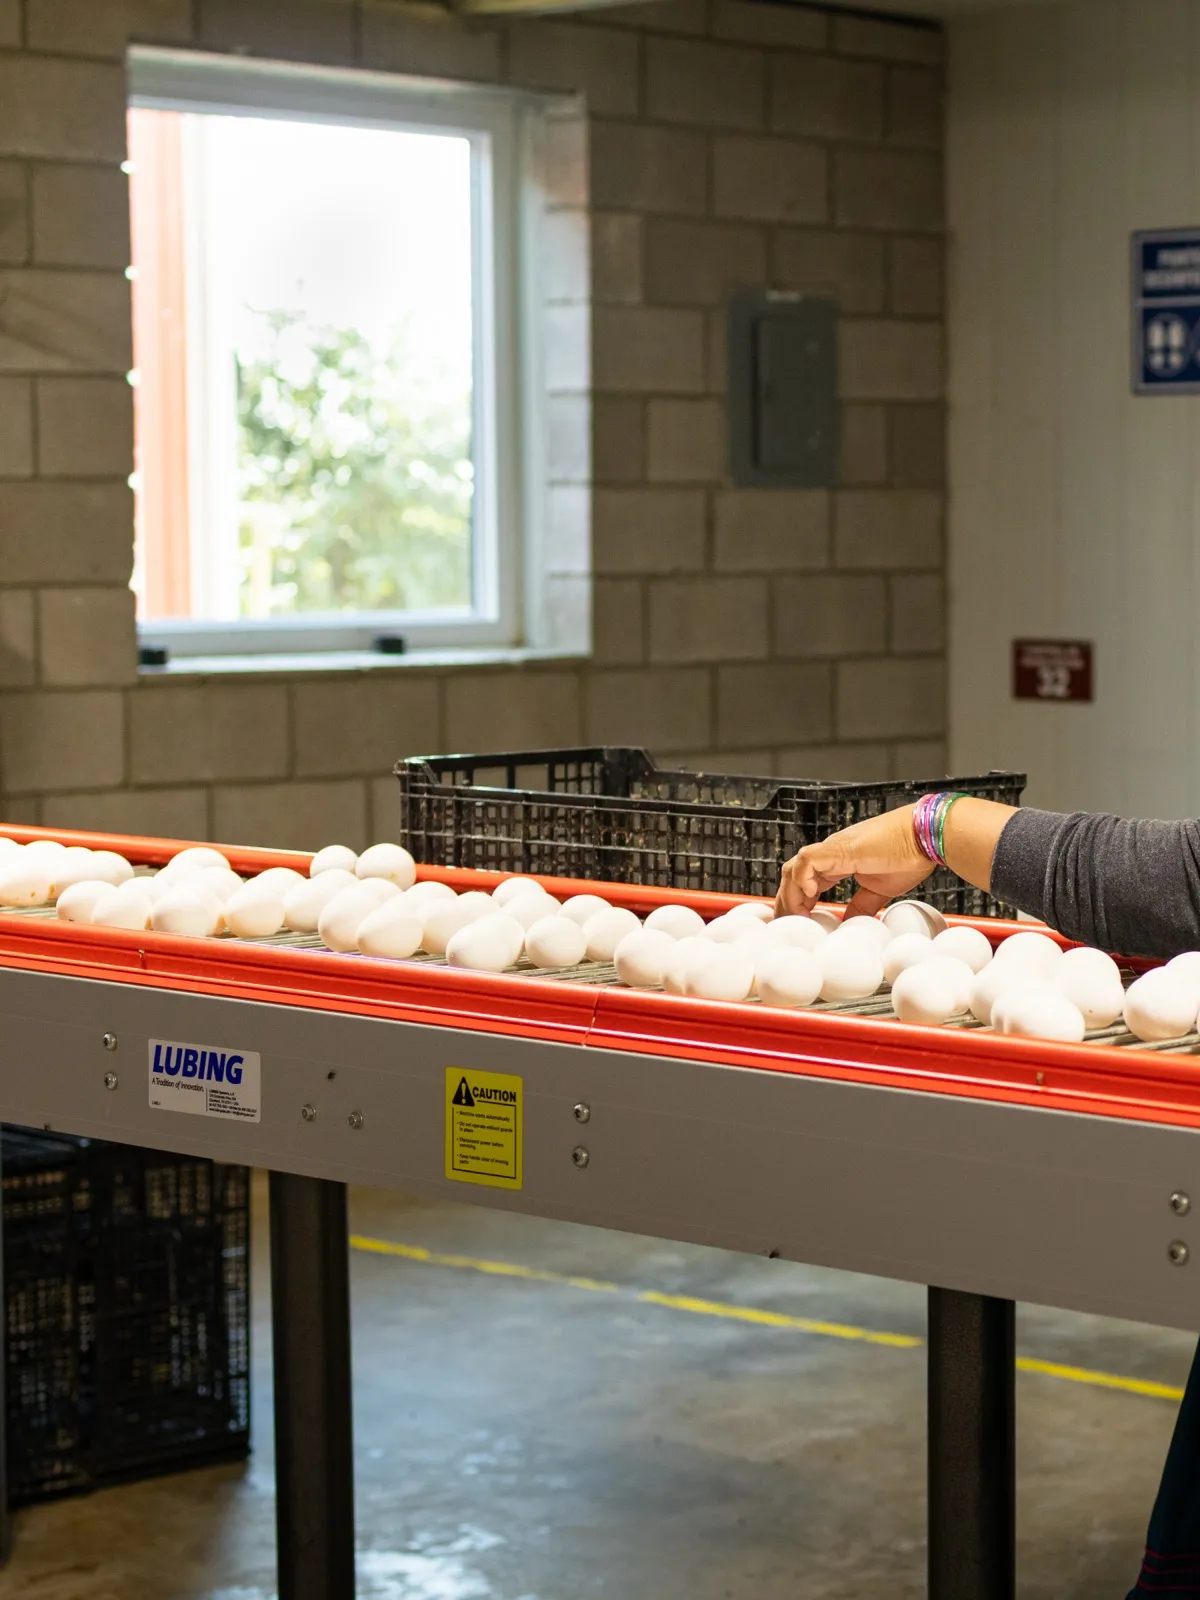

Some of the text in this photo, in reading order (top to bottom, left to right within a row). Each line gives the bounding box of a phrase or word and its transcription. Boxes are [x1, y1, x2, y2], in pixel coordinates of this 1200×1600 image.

[152, 1044, 244, 1085] LUBING
[152, 1077, 156, 1085] A
[156, 1078, 174, 1088] Tradition
[175, 1081, 181, 1089] of
[472, 1086, 516, 1102] CAUTION
